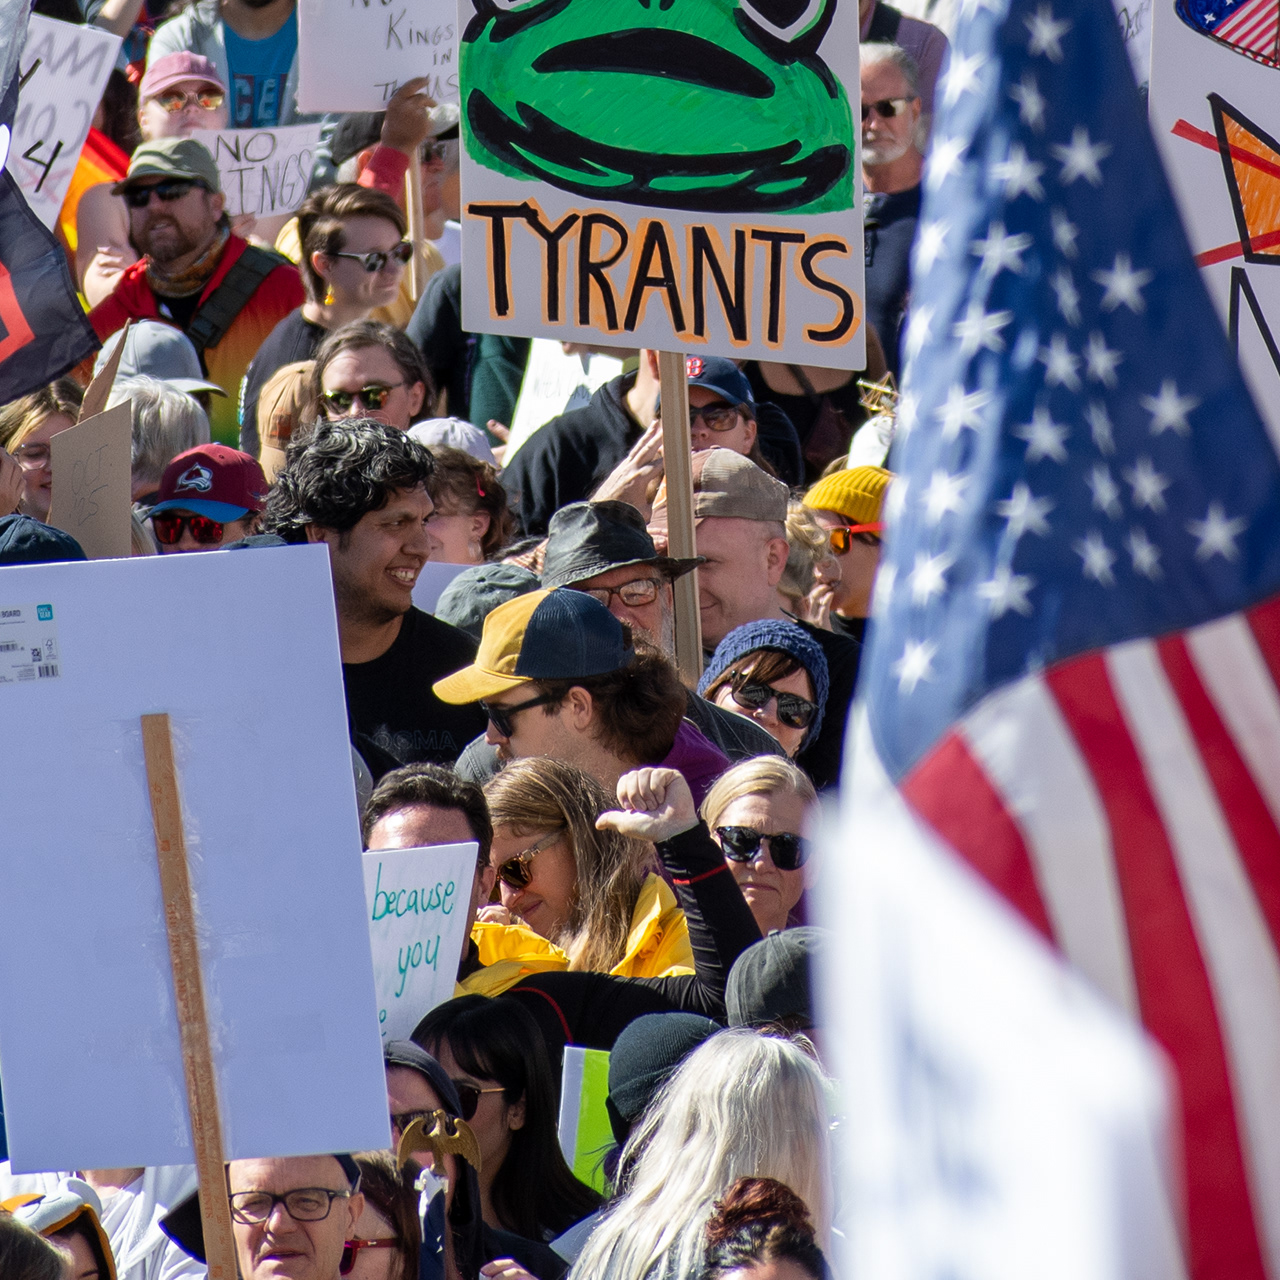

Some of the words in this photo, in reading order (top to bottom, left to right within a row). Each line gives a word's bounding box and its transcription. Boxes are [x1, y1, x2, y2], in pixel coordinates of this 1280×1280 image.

[215, 131, 277, 163] NO
[227, 148, 314, 215] INGS
[464, 197, 860, 350] TYRANTS
[1, 609, 21, 618] BOARD
[372, 862, 455, 922] because
[397, 933, 442, 998] you
